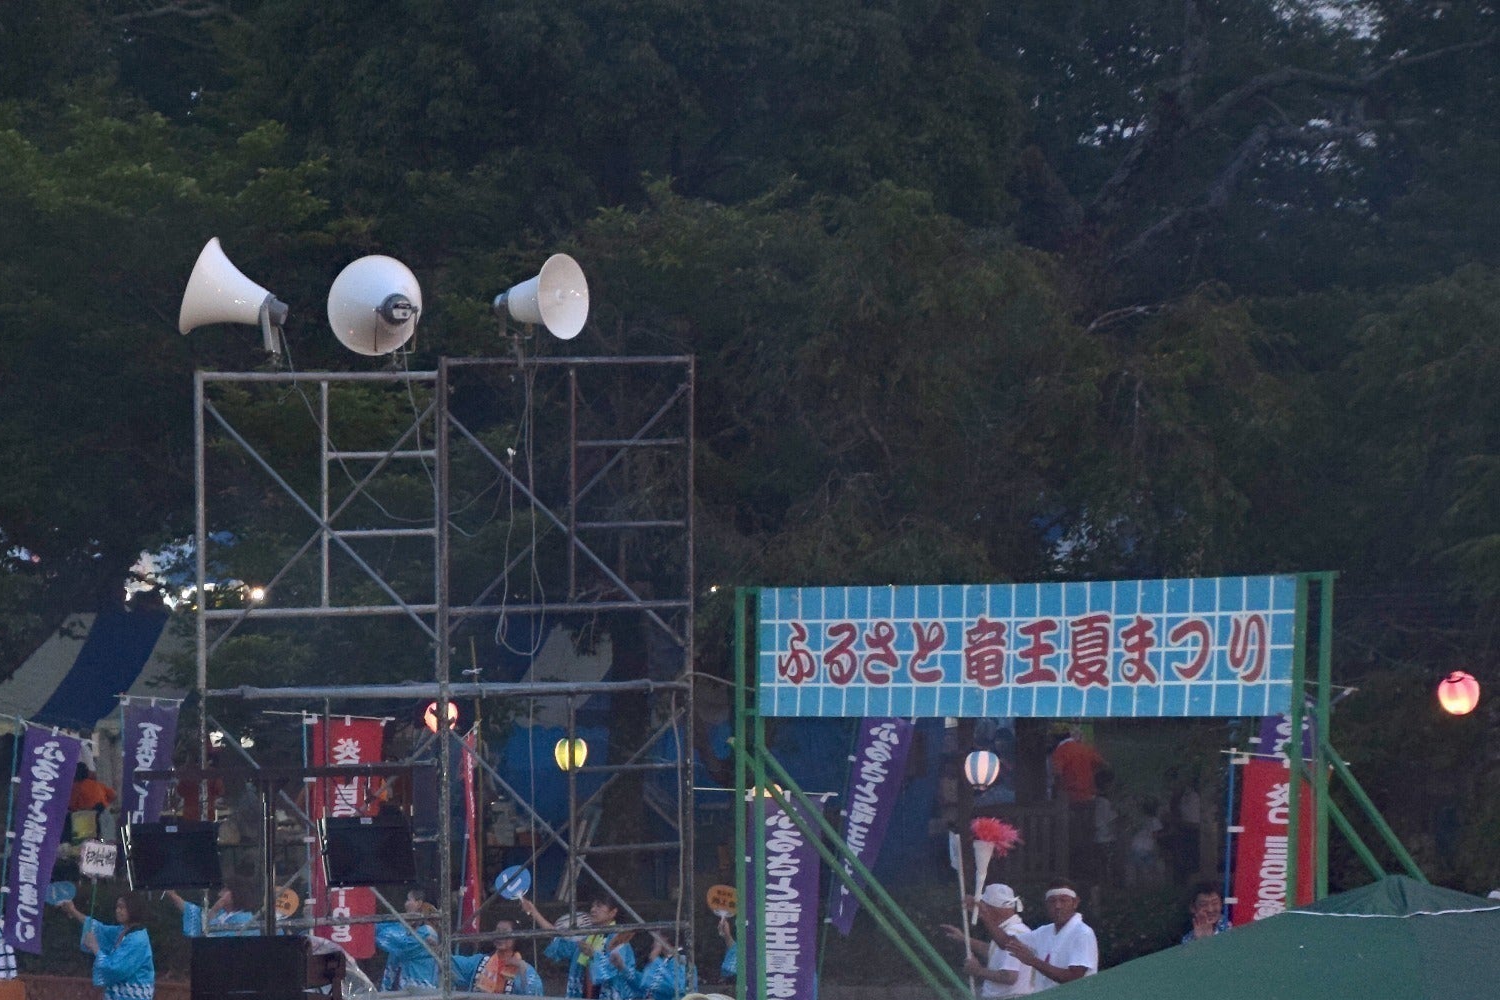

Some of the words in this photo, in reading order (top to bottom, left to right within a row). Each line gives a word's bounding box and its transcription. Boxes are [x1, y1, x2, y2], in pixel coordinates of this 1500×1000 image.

[777, 614, 1268, 688] ふるさと竜王夏まつり
